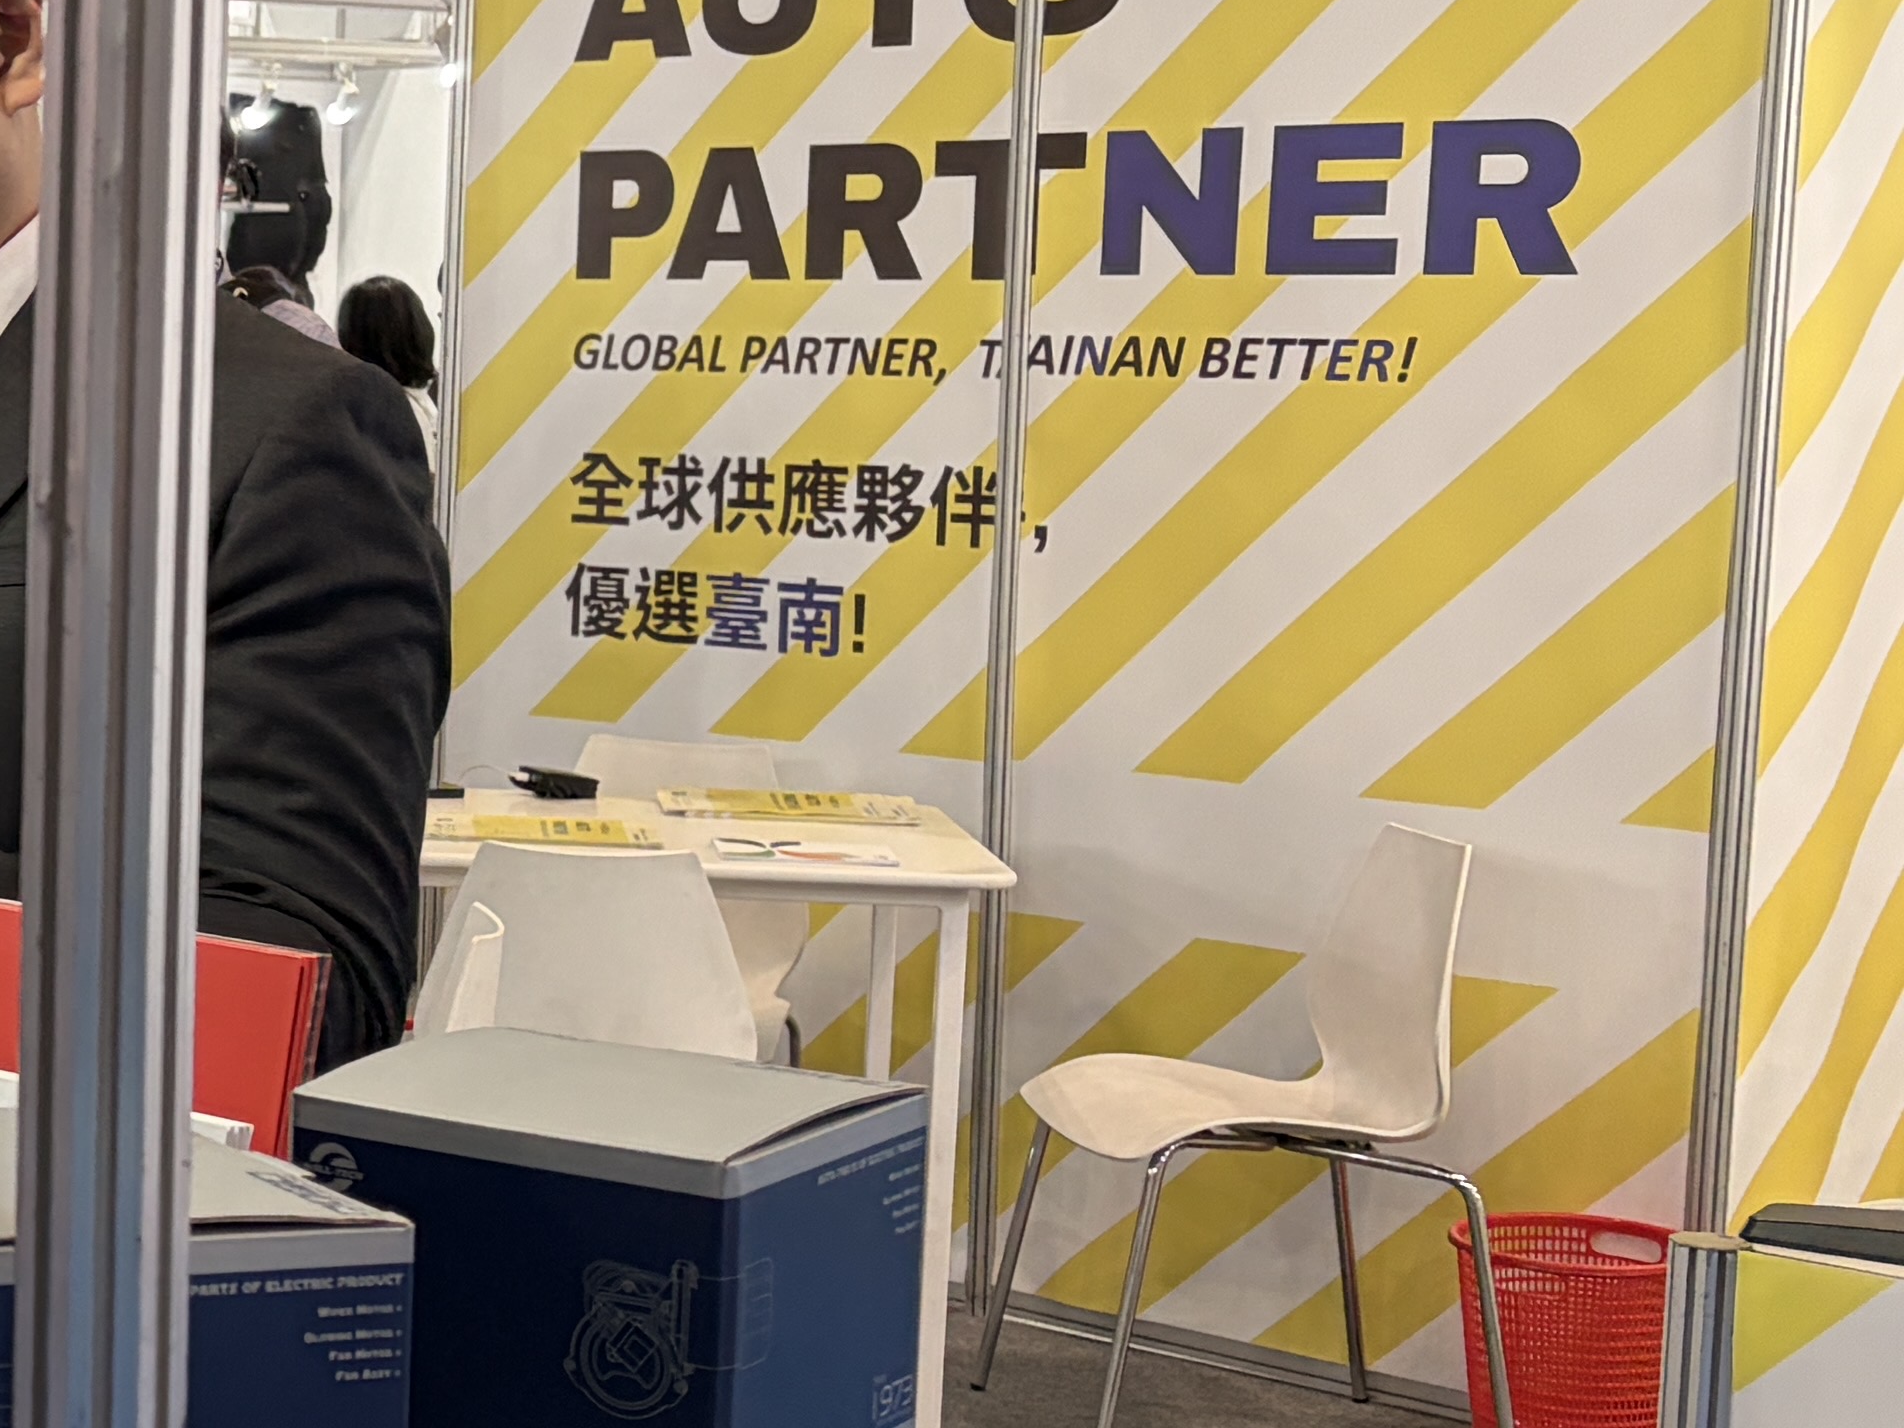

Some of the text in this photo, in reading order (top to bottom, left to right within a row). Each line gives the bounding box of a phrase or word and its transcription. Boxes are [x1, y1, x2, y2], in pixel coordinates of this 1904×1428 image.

[573, 118, 1582, 281] PARTNER
[572, 332, 728, 374] GLOBAL
[739, 334, 949, 386] PARTNER,
[1196, 335, 1420, 383] BETTER!
[564, 560, 867, 659] 優選臺南!
[190, 1273, 404, 1296] PARTS OF ELECTRIC PRODUCT
